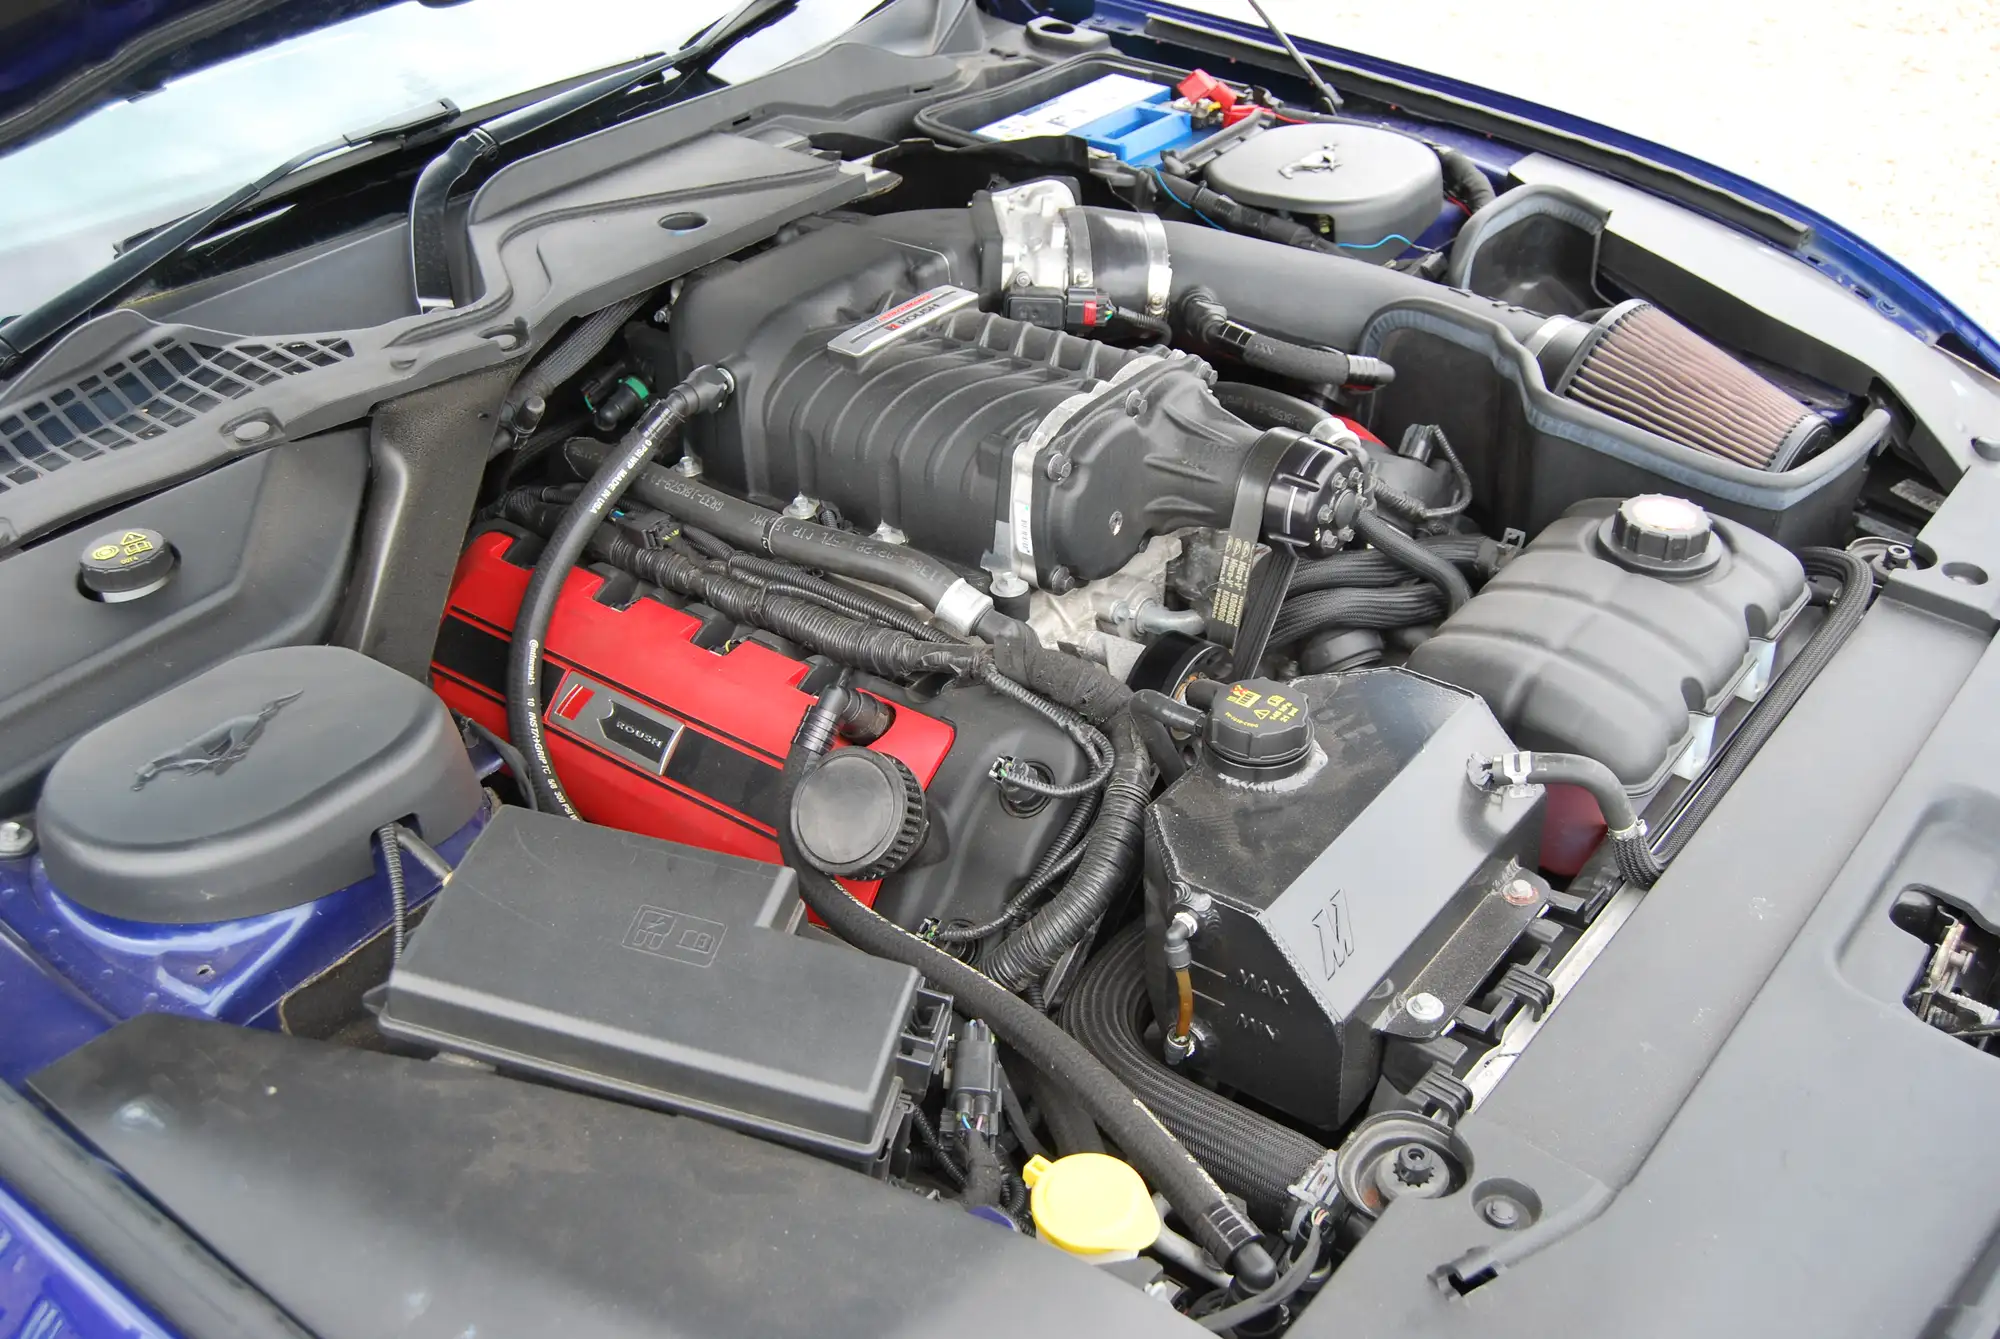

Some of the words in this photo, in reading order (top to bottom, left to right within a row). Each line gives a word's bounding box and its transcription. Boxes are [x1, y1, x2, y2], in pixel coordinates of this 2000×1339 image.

[634, 444, 648, 460] PSI
[627, 455, 639, 470] WP
[608, 469, 628, 492] MADE
[601, 488, 612, 500] IN
[589, 497, 606, 514] USA
[616, 720, 663, 748] ROUSH
[1236, 968, 1290, 1005] MAX
